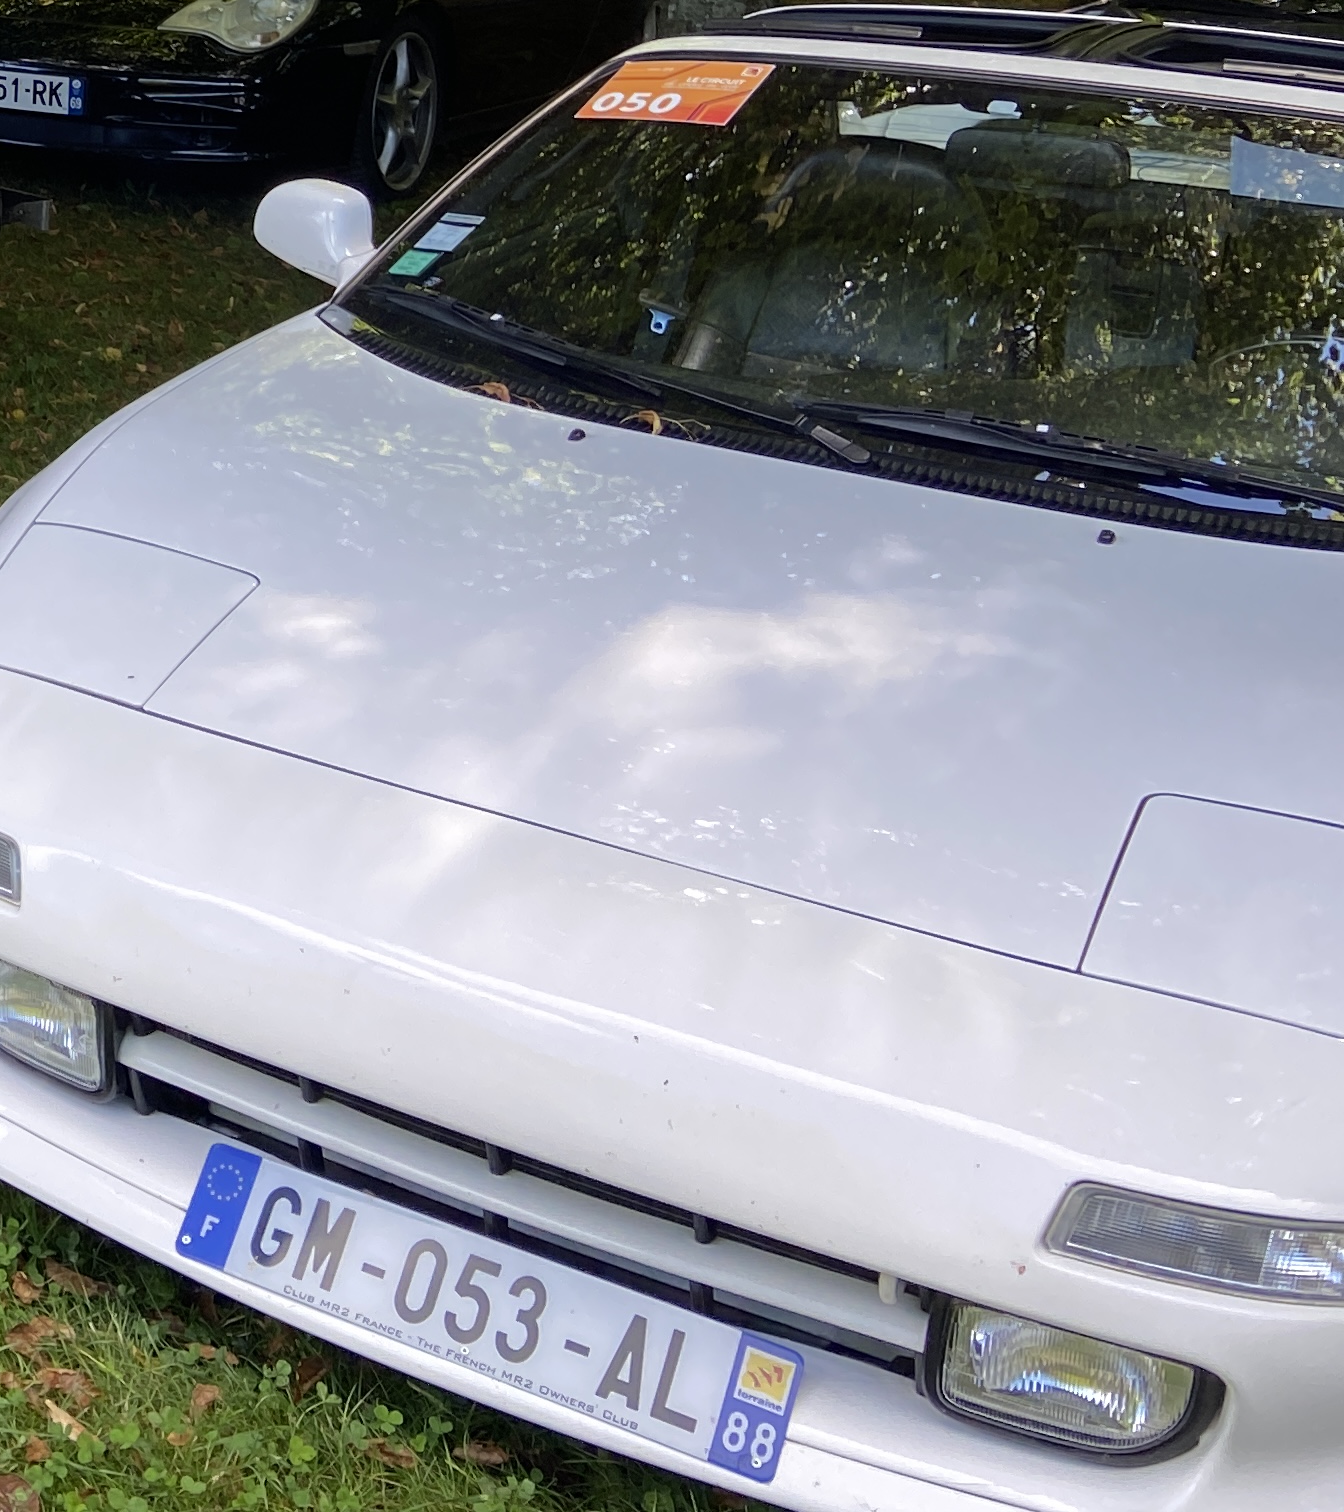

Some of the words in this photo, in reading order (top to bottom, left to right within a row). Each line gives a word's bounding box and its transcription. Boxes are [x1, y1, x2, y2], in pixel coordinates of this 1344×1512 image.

[700, 77, 746, 85] CIRCUIT
[70, 96, 82, 110] 69
[591, 91, 682, 115] 050
[199, 1214, 220, 1238] F
[250, 1186, 698, 1434] GM-053-AL
[320, 1299, 350, 1317] MR2
[355, 1313, 404, 1338] FRANCE
[501, 1369, 534, 1390] MR2
[737, 1388, 784, 1413] lorraine
[722, 1411, 777, 1465] 88
